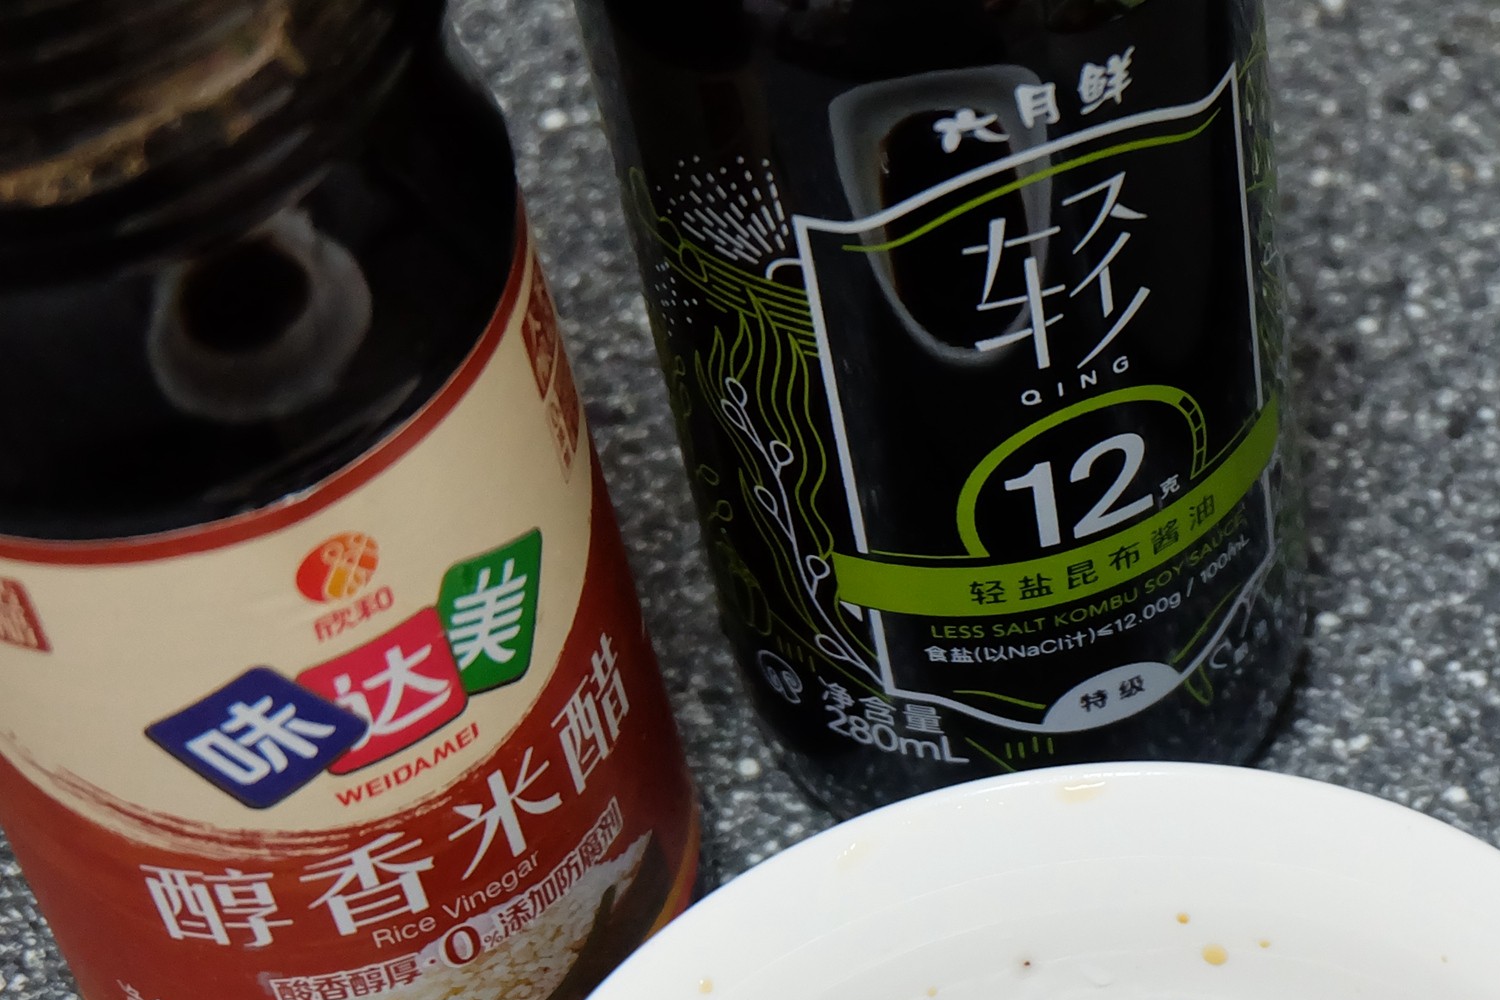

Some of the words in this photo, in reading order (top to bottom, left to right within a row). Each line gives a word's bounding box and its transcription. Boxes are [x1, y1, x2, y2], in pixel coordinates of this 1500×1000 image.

[1021, 354, 1130, 406] QING
[930, 623, 985, 639] LESS
[991, 619, 1044, 638] SALT
[1054, 588, 1139, 627] KOMBU
[1144, 564, 1184, 594] SOY
[1189, 507, 1248, 567] SAUCE
[969, 493, 1216, 606] 轻盐昆布酱油
[312, 584, 396, 643] 欣和
[184, 557, 529, 787] 味达美
[818, 675, 945, 734] 净含量
[1079, 675, 1147, 712] 特级
[334, 721, 480, 807] WEIDAMEI
[825, 704, 970, 763] 280mL
[139, 631, 632, 950] 醇香米醋
[371, 914, 437, 950] Rice
[441, 851, 540, 920] Vinegar
